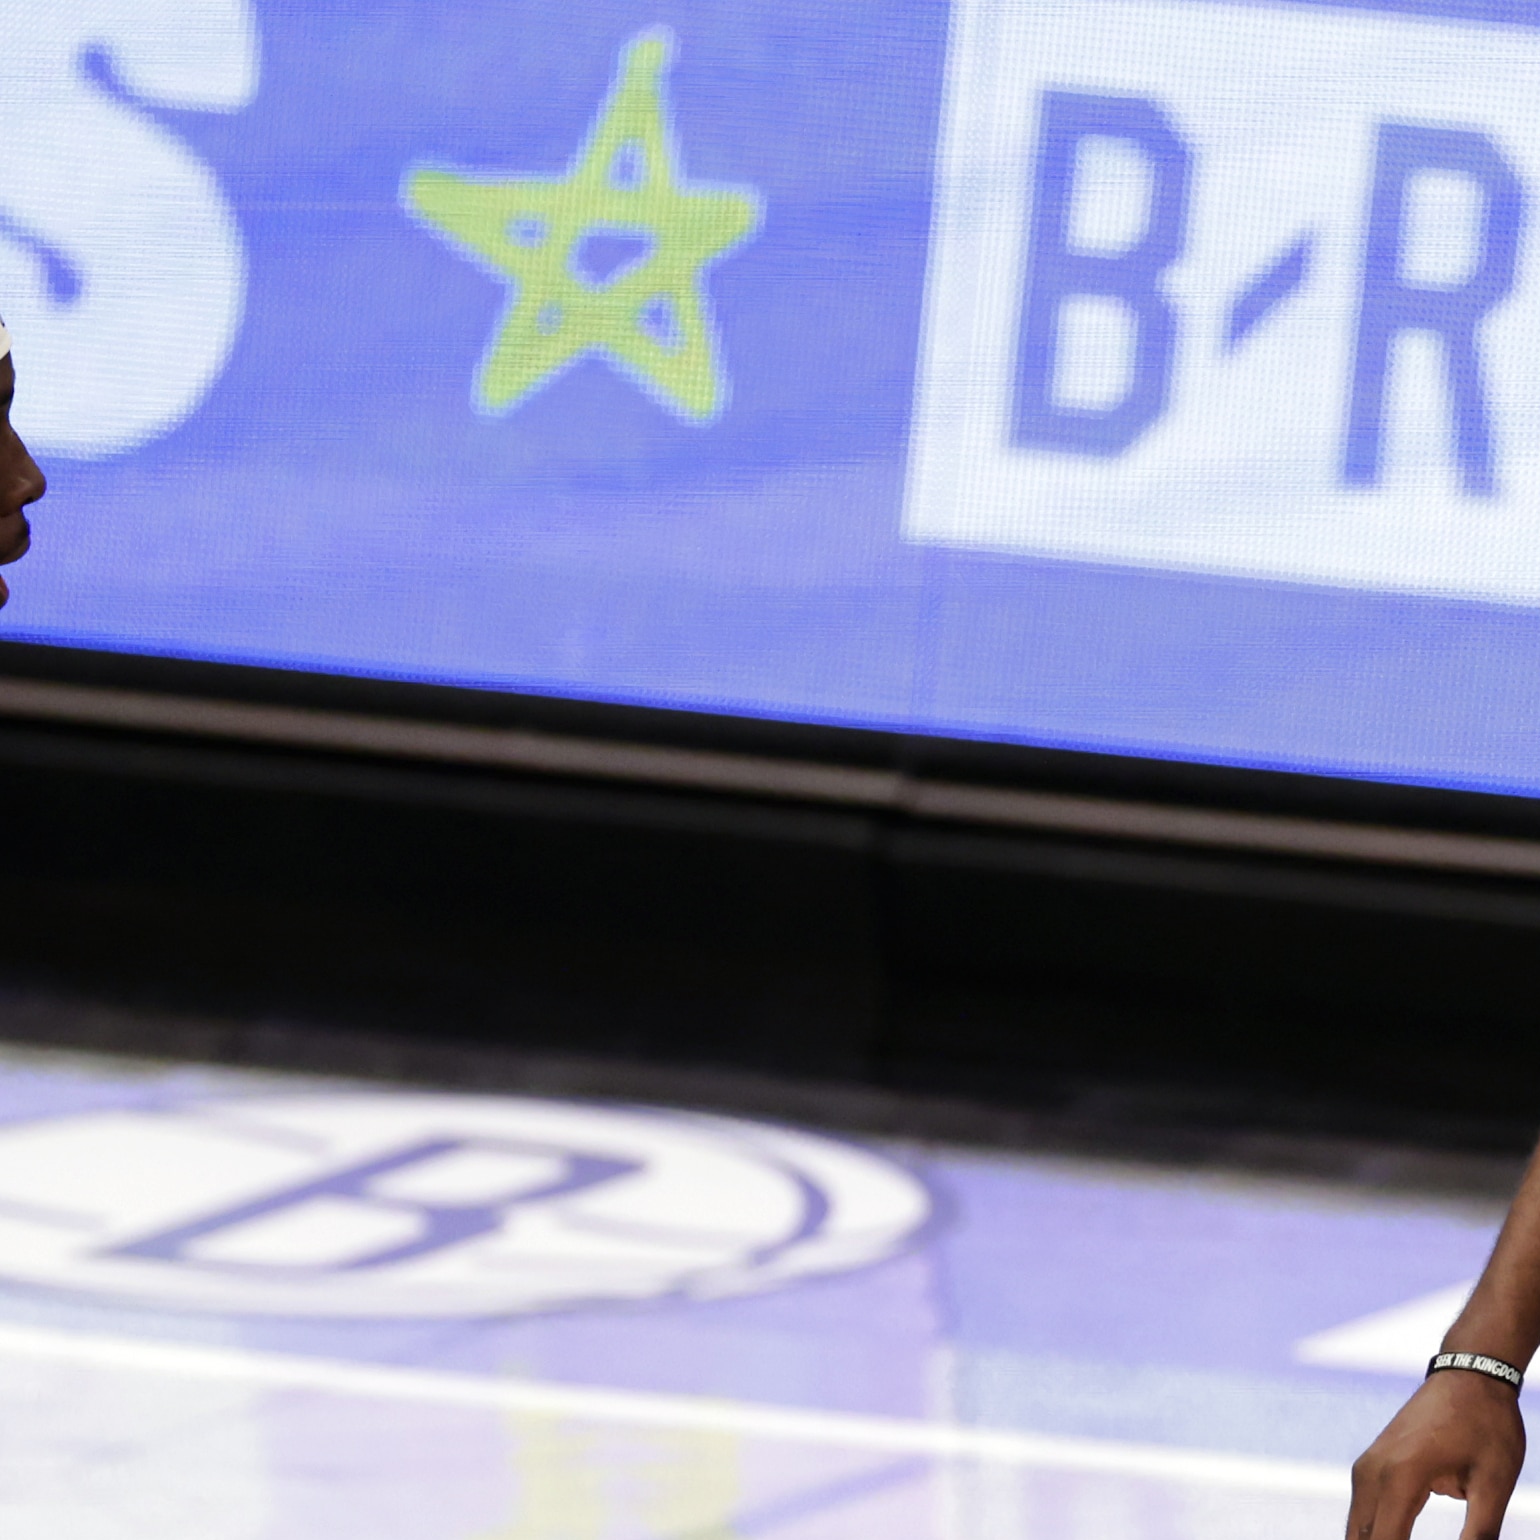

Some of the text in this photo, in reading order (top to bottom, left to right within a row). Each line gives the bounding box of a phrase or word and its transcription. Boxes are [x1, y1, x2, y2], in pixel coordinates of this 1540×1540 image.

[1434, 1353, 1521, 1386] SEEK THE KINGDOM
